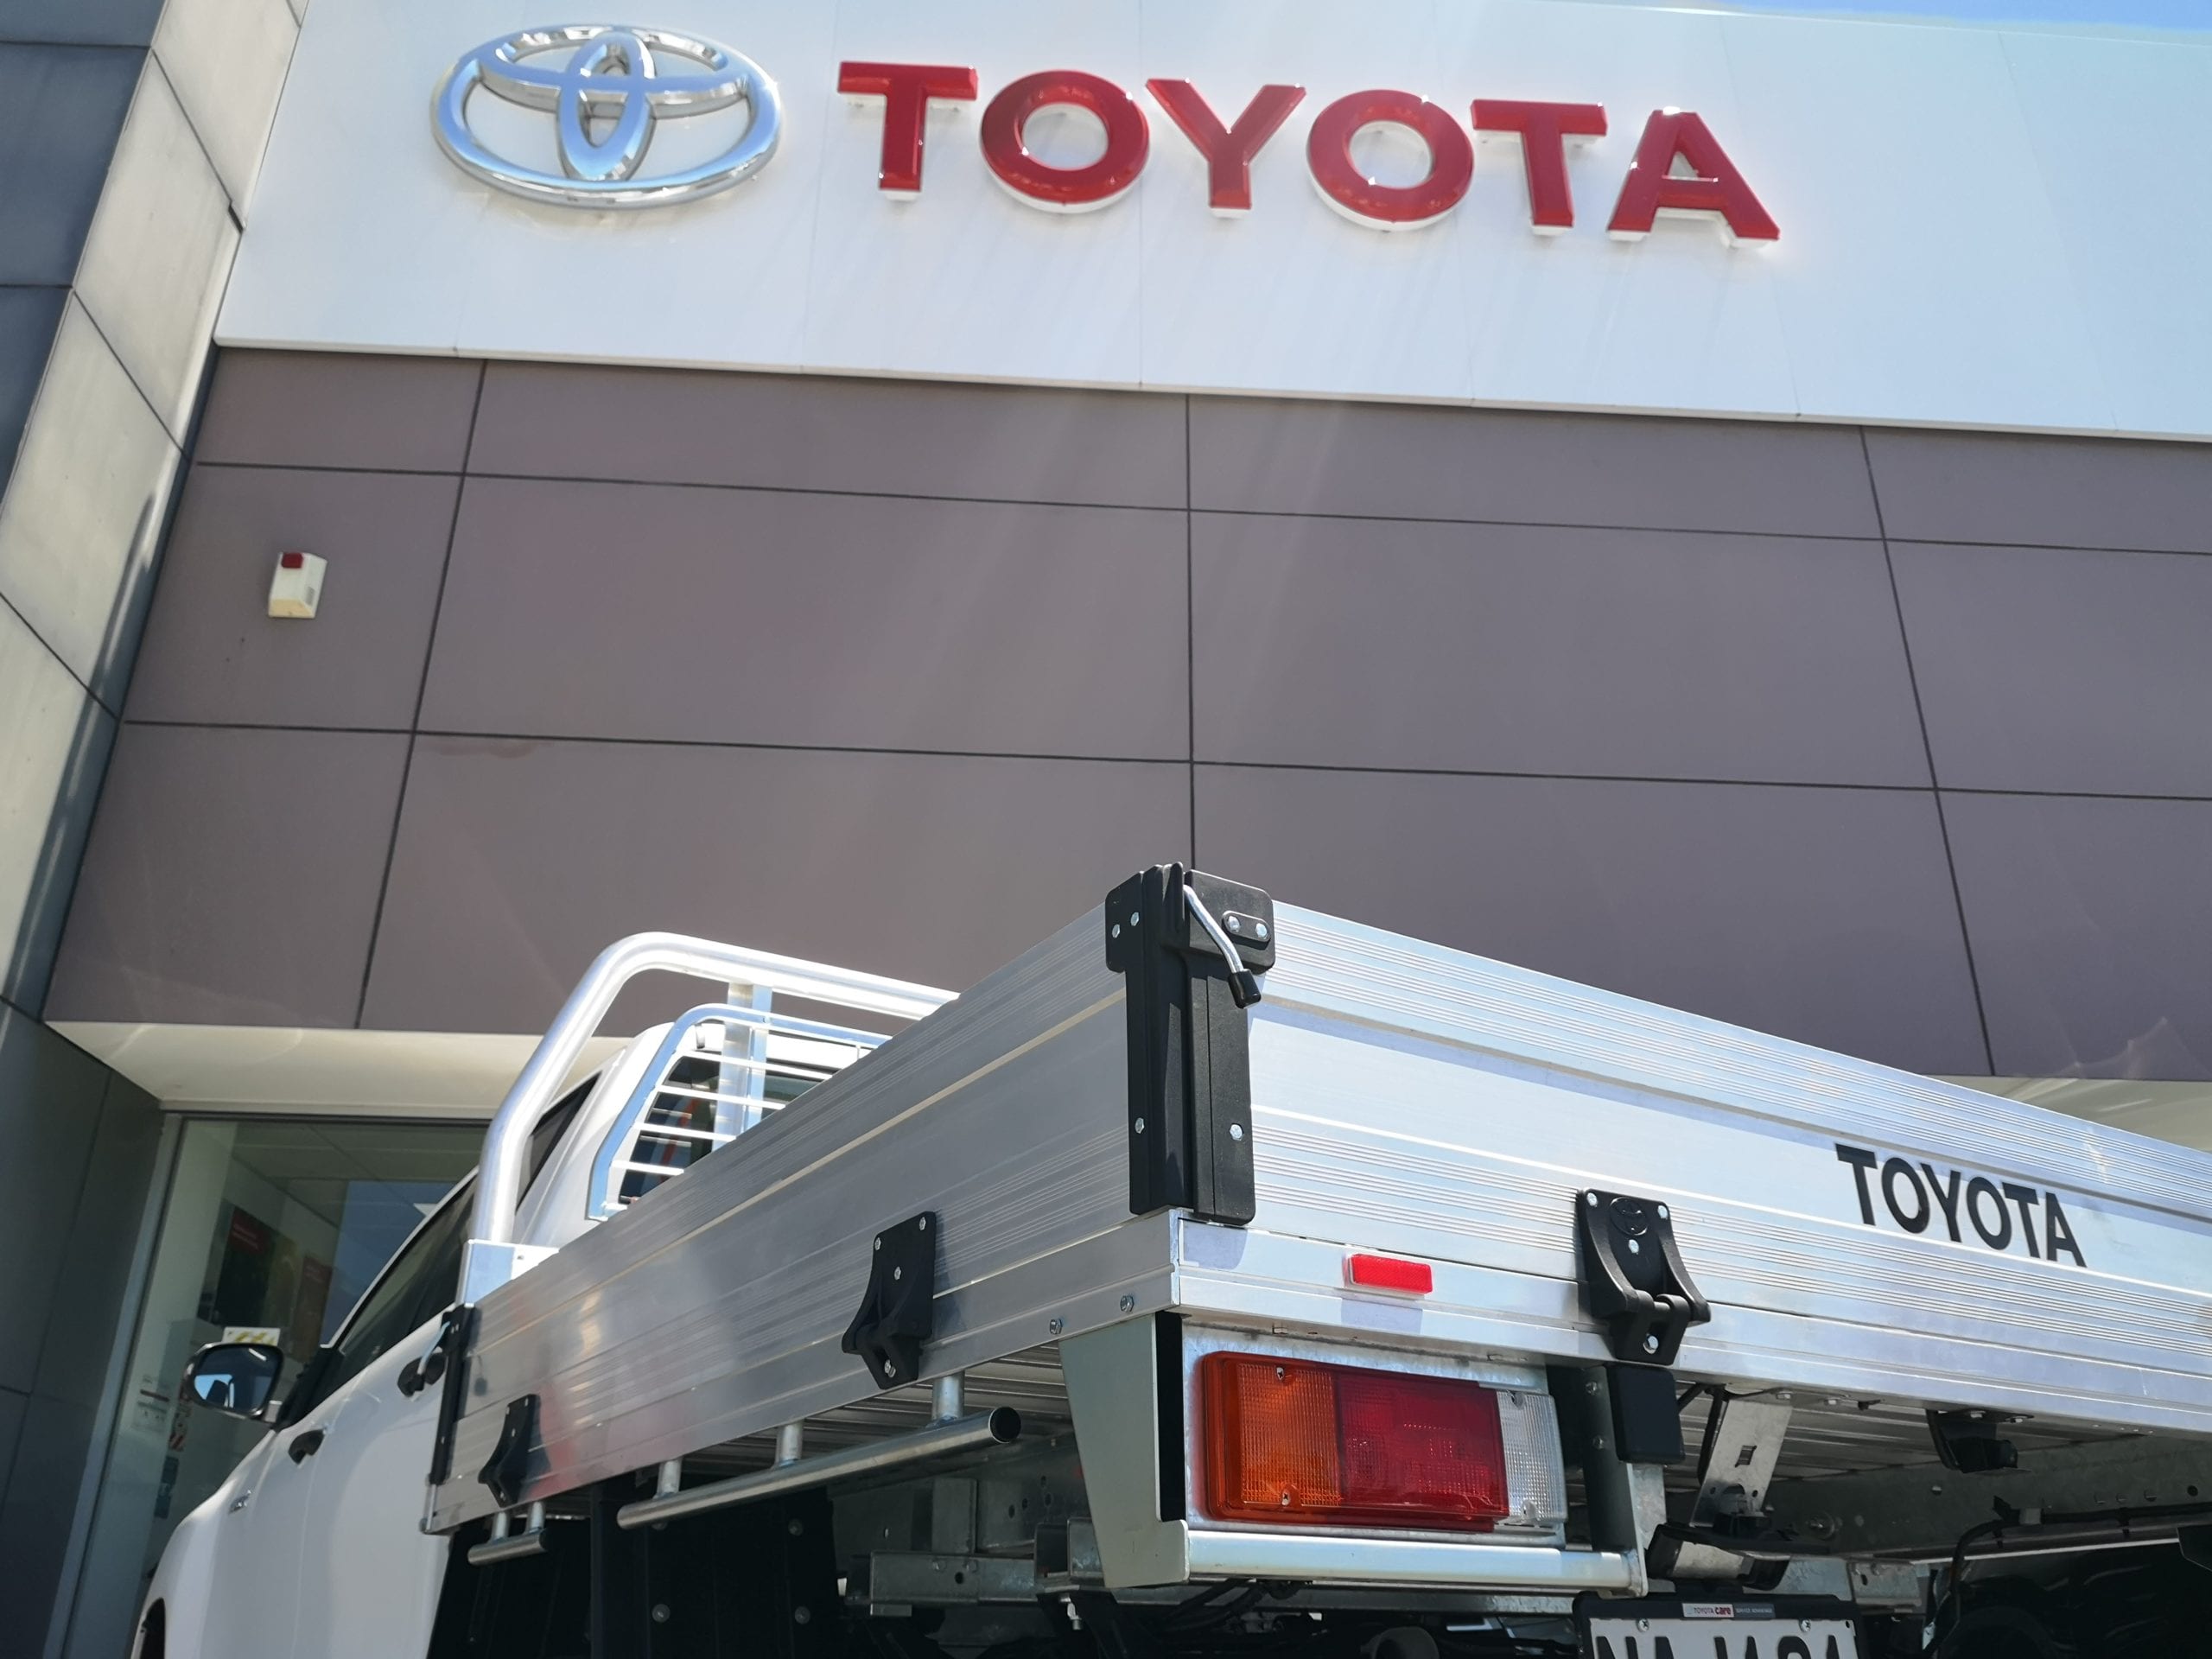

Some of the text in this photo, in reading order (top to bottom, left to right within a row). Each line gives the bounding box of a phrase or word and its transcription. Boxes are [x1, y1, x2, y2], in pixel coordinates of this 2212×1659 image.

[837, 61, 1783, 242] TOYOTA
[1835, 1142, 2088, 1268] TOYOTA
[1694, 1606, 1714, 1615] TOYOTA
